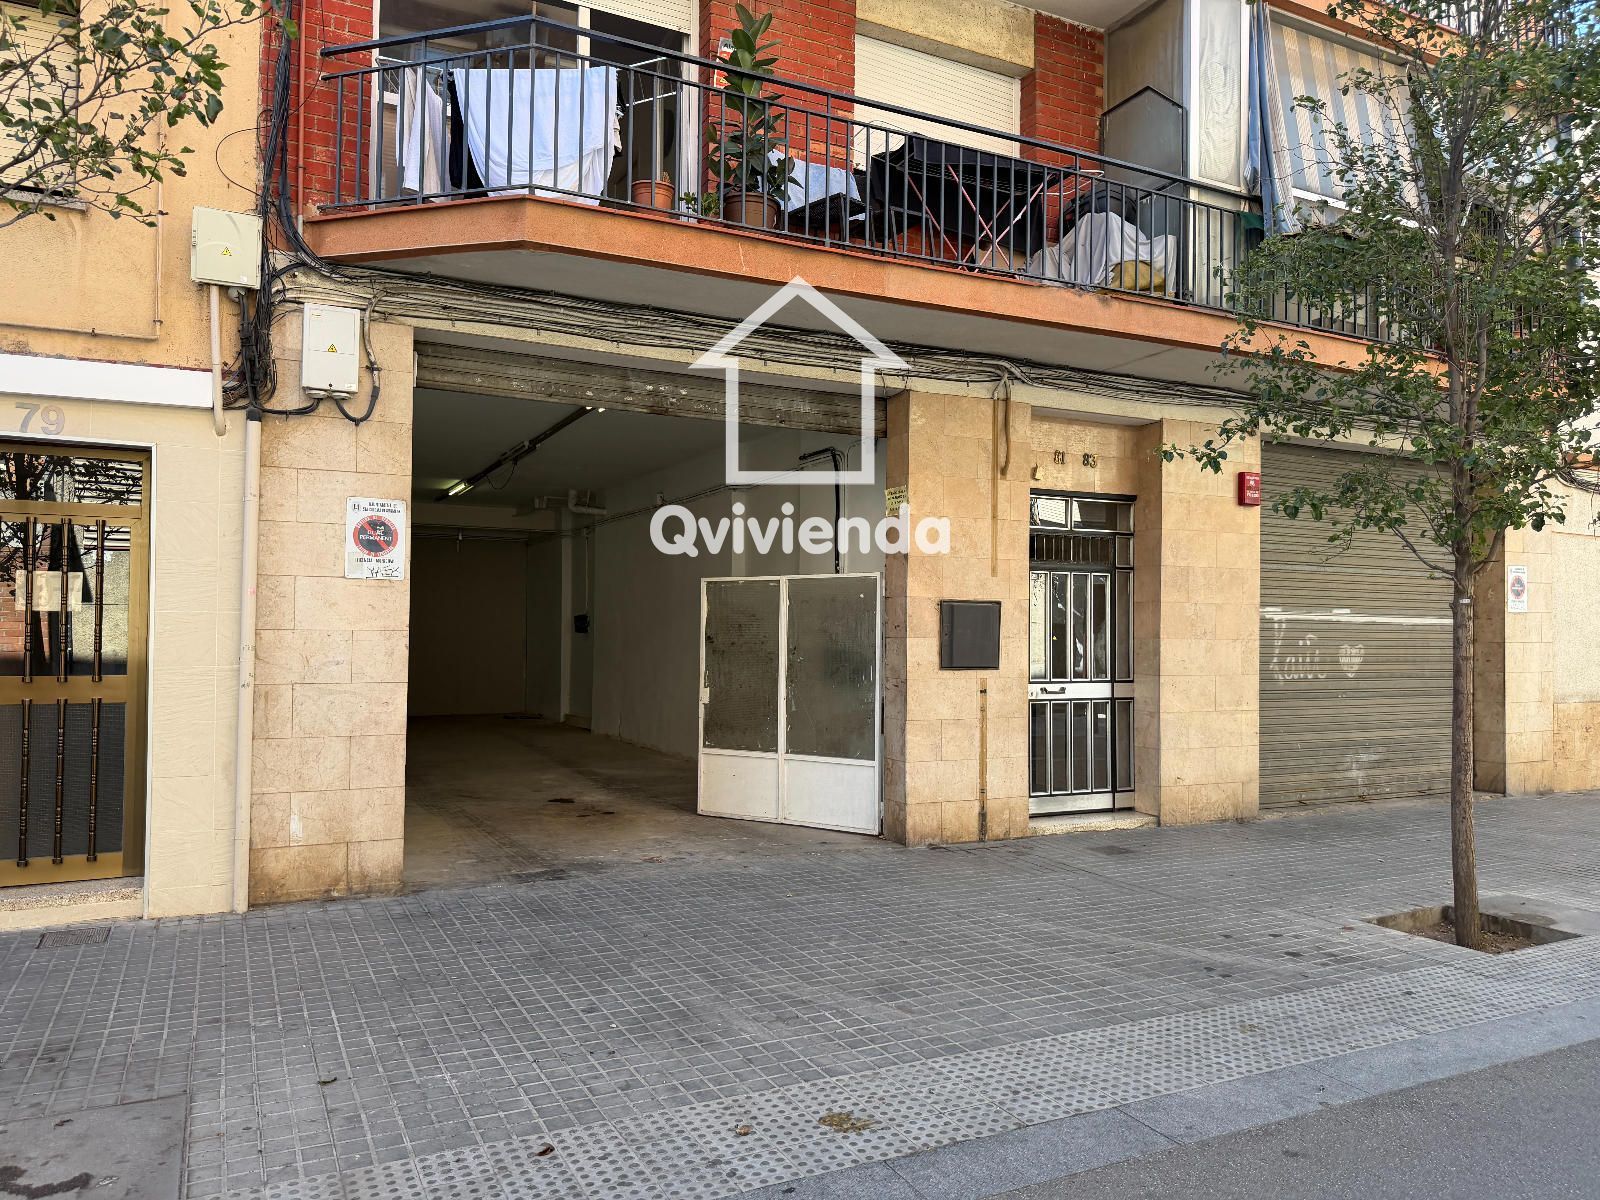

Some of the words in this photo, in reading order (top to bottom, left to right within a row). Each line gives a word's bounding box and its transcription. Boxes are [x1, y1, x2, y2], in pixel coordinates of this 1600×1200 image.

[15, 402, 65, 435] 79
[1082, 453, 1098, 469] 83
[359, 534, 393, 542] PERMANENT
